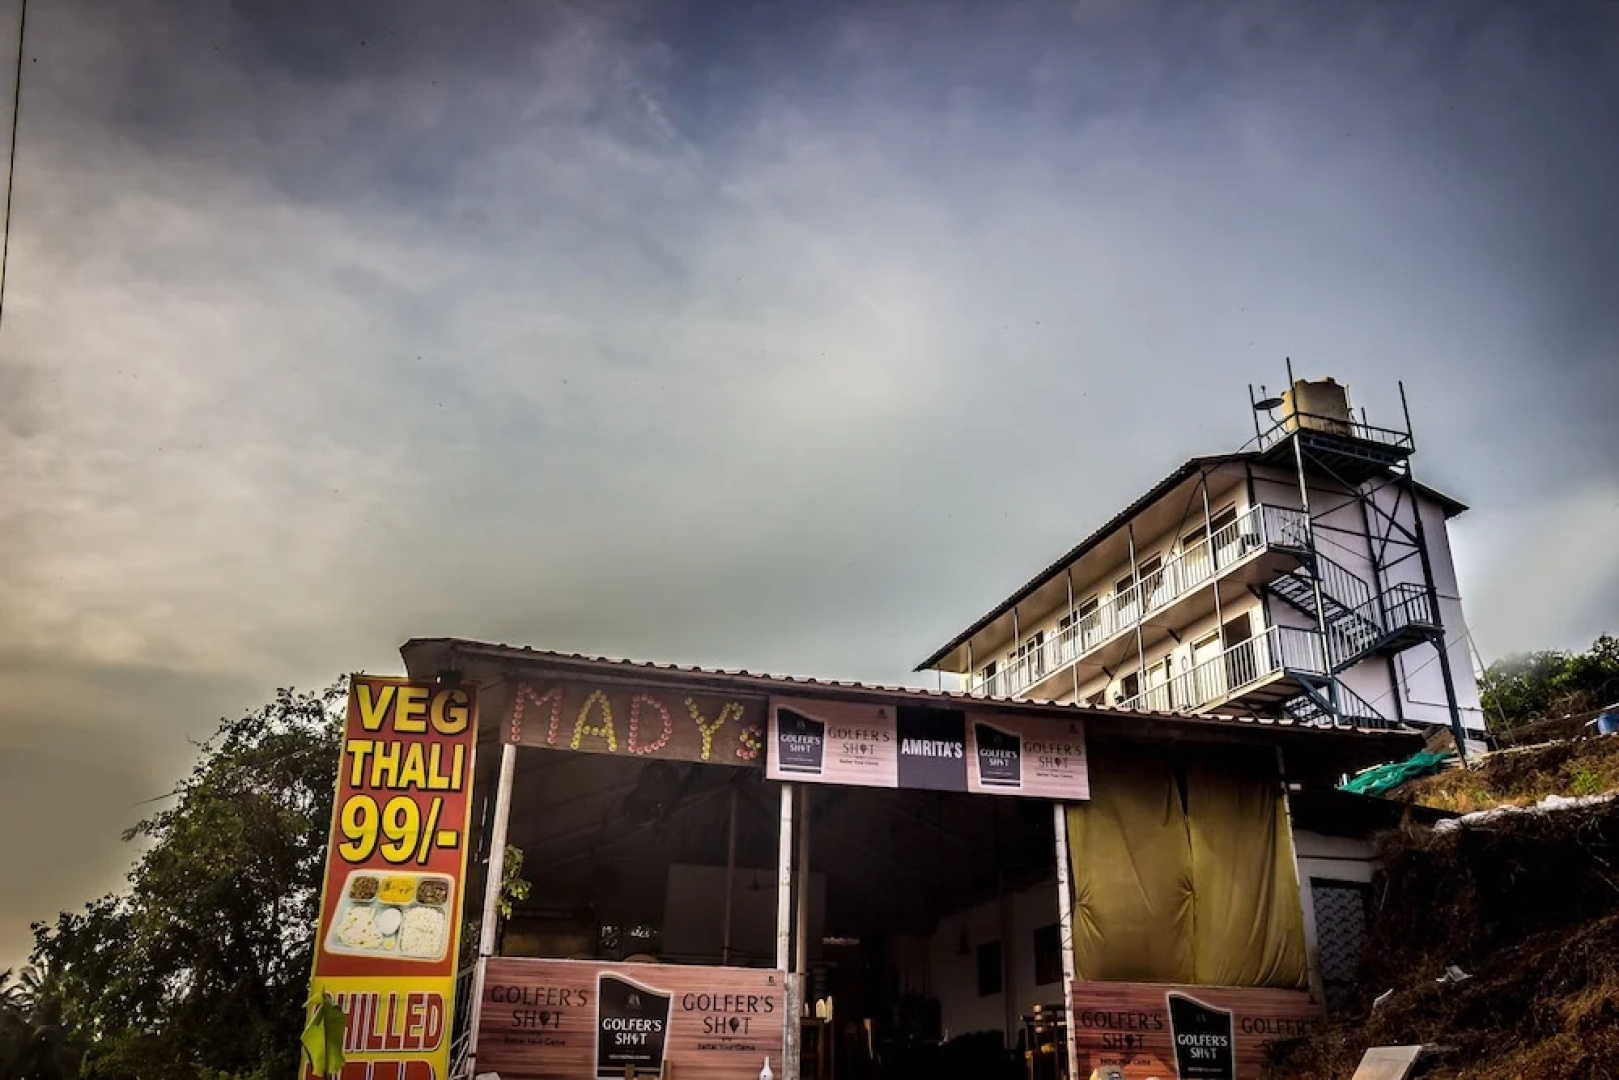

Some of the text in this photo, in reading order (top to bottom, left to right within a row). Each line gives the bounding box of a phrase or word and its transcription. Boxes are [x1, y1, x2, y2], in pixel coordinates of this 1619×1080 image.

[356, 684, 470, 735] VEG
[828, 726, 890, 742] GOLFER'S
[900, 736, 964, 760] AMRITA'S
[1023, 740, 1082, 756] GOLFER'S
[346, 738, 465, 790] THALI
[337, 794, 457, 864] 99/-
[491, 985, 588, 1008] GOLFER'S
[682, 993, 774, 1013] GOLFER'S
[312, 990, 446, 1053] HILLED
[602, 1017, 662, 1032] GOLFER'S
[1082, 1011, 1164, 1031] GOLFER'S
[1177, 1033, 1228, 1047] GOLFER'S
